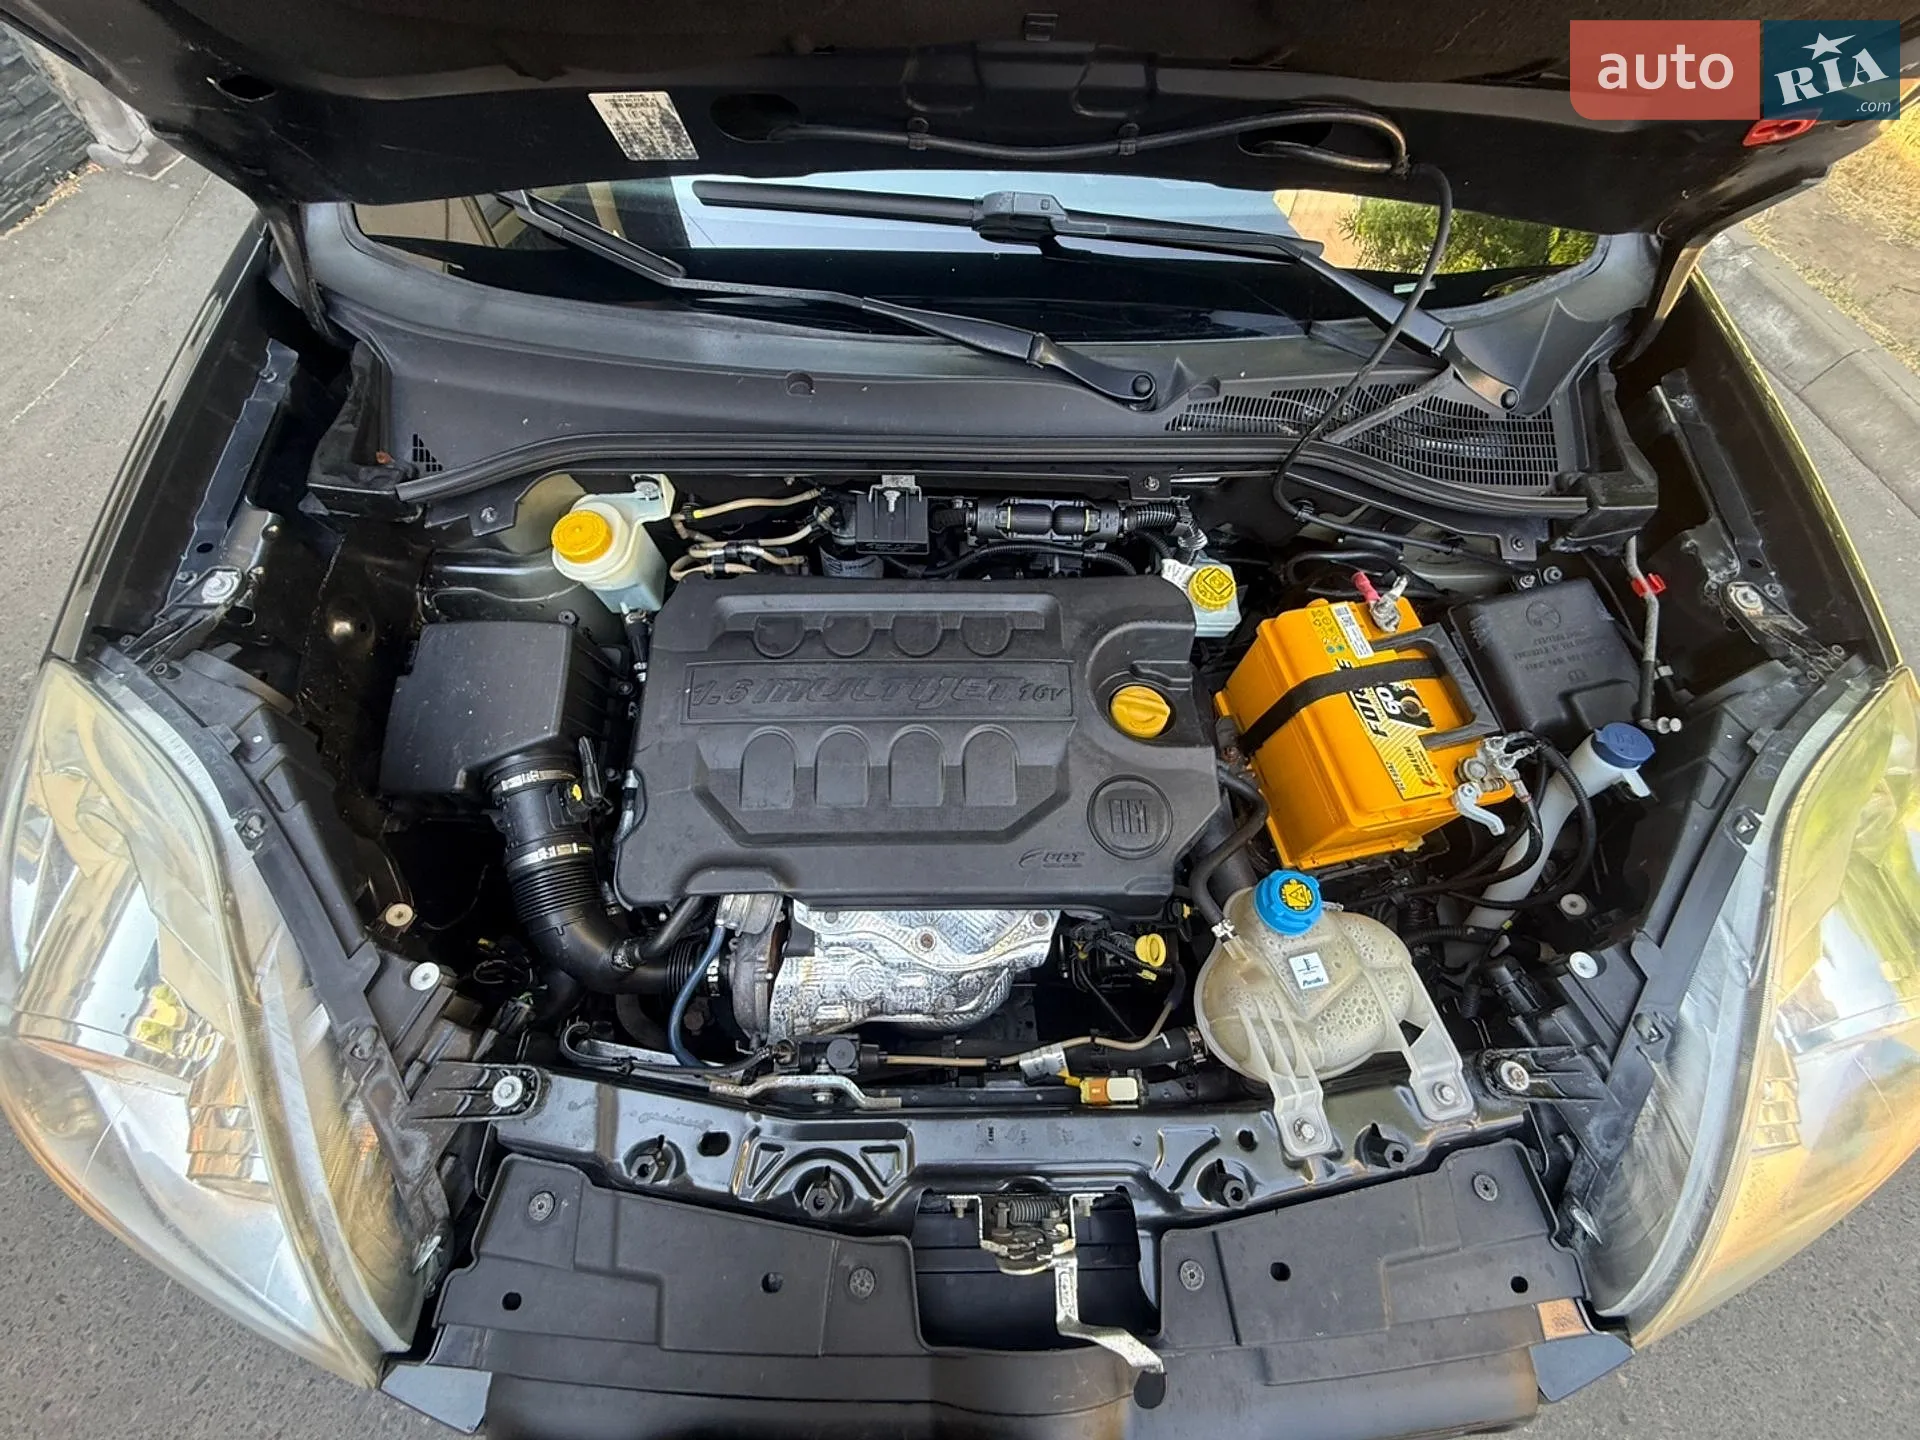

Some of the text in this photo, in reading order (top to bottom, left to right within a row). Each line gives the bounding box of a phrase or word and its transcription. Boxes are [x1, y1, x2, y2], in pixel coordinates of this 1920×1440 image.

[692, 678, 753, 706] 1.6
[1335, 659, 1388, 736] FORE
[1374, 684, 1400, 716] 60
